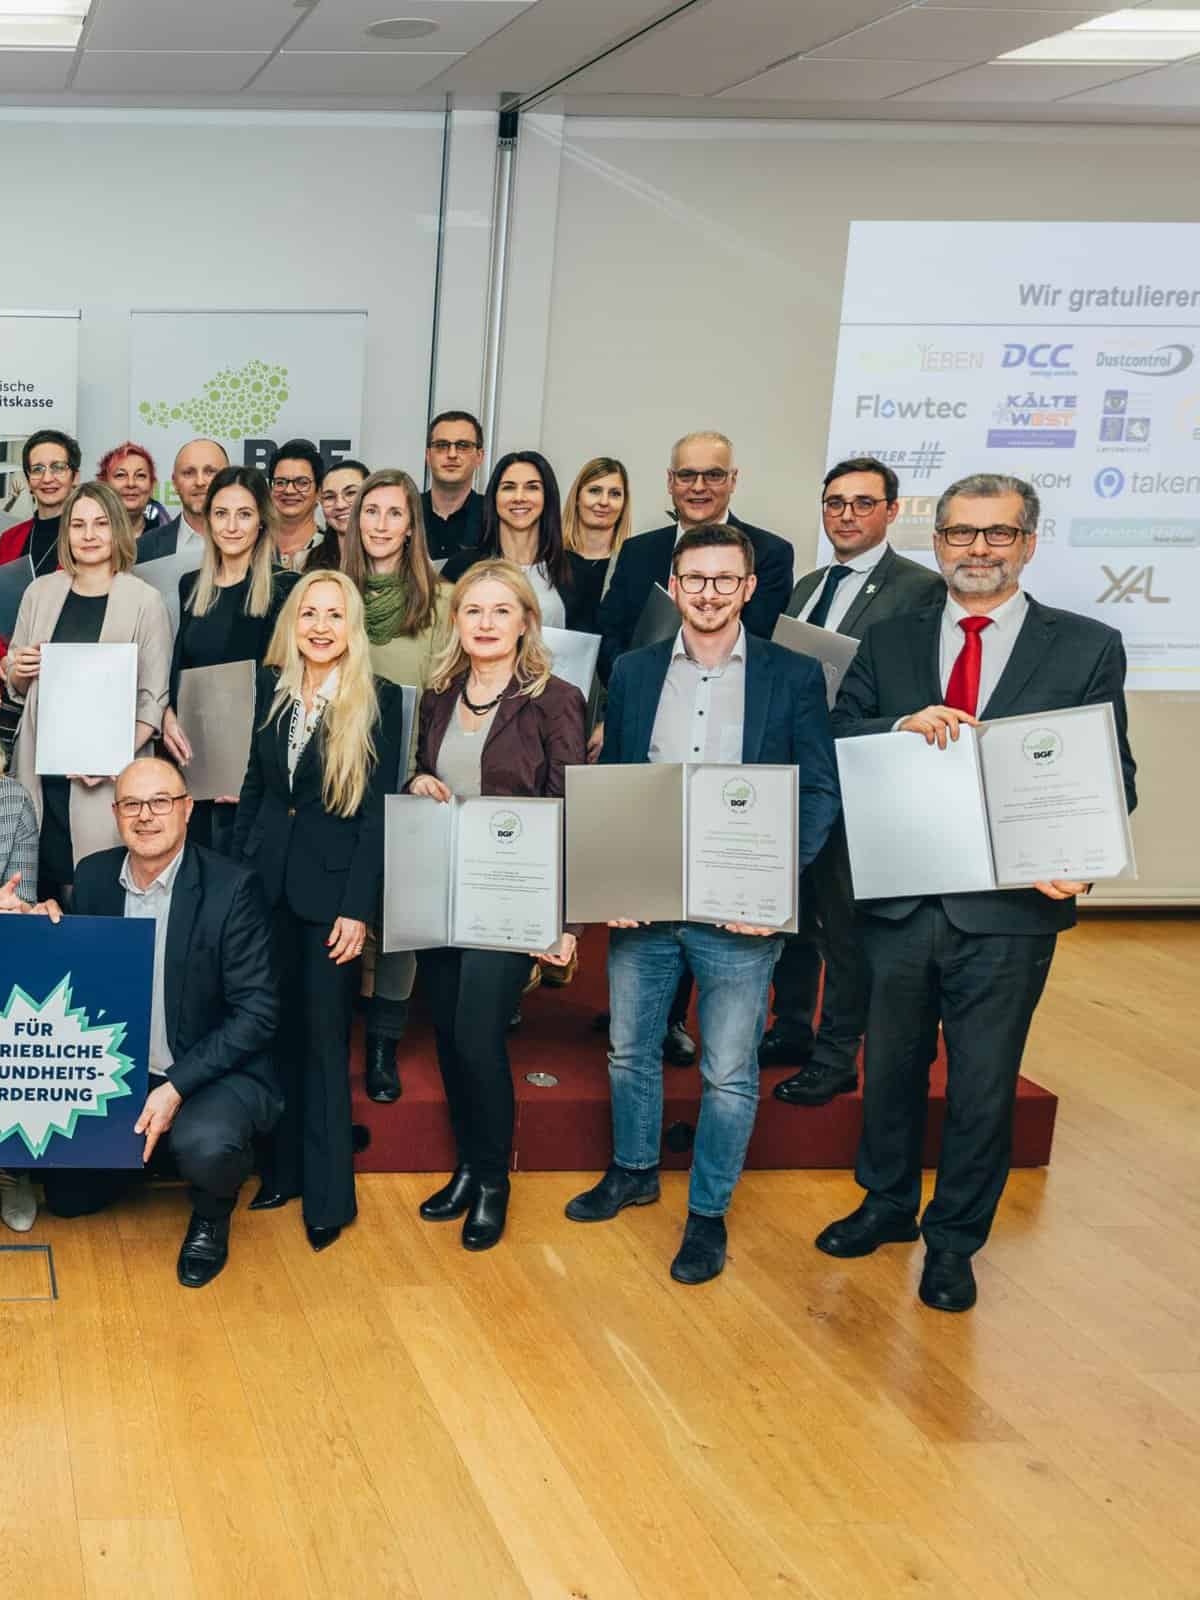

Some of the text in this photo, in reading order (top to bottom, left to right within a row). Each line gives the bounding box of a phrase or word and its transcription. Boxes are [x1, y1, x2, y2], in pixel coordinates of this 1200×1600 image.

[1018, 283, 1062, 307] Wir
[1001, 344, 1073, 368] DCC
[856, 394, 968, 419] Flowtec
[13, 1017, 54, 1037] FÜR
